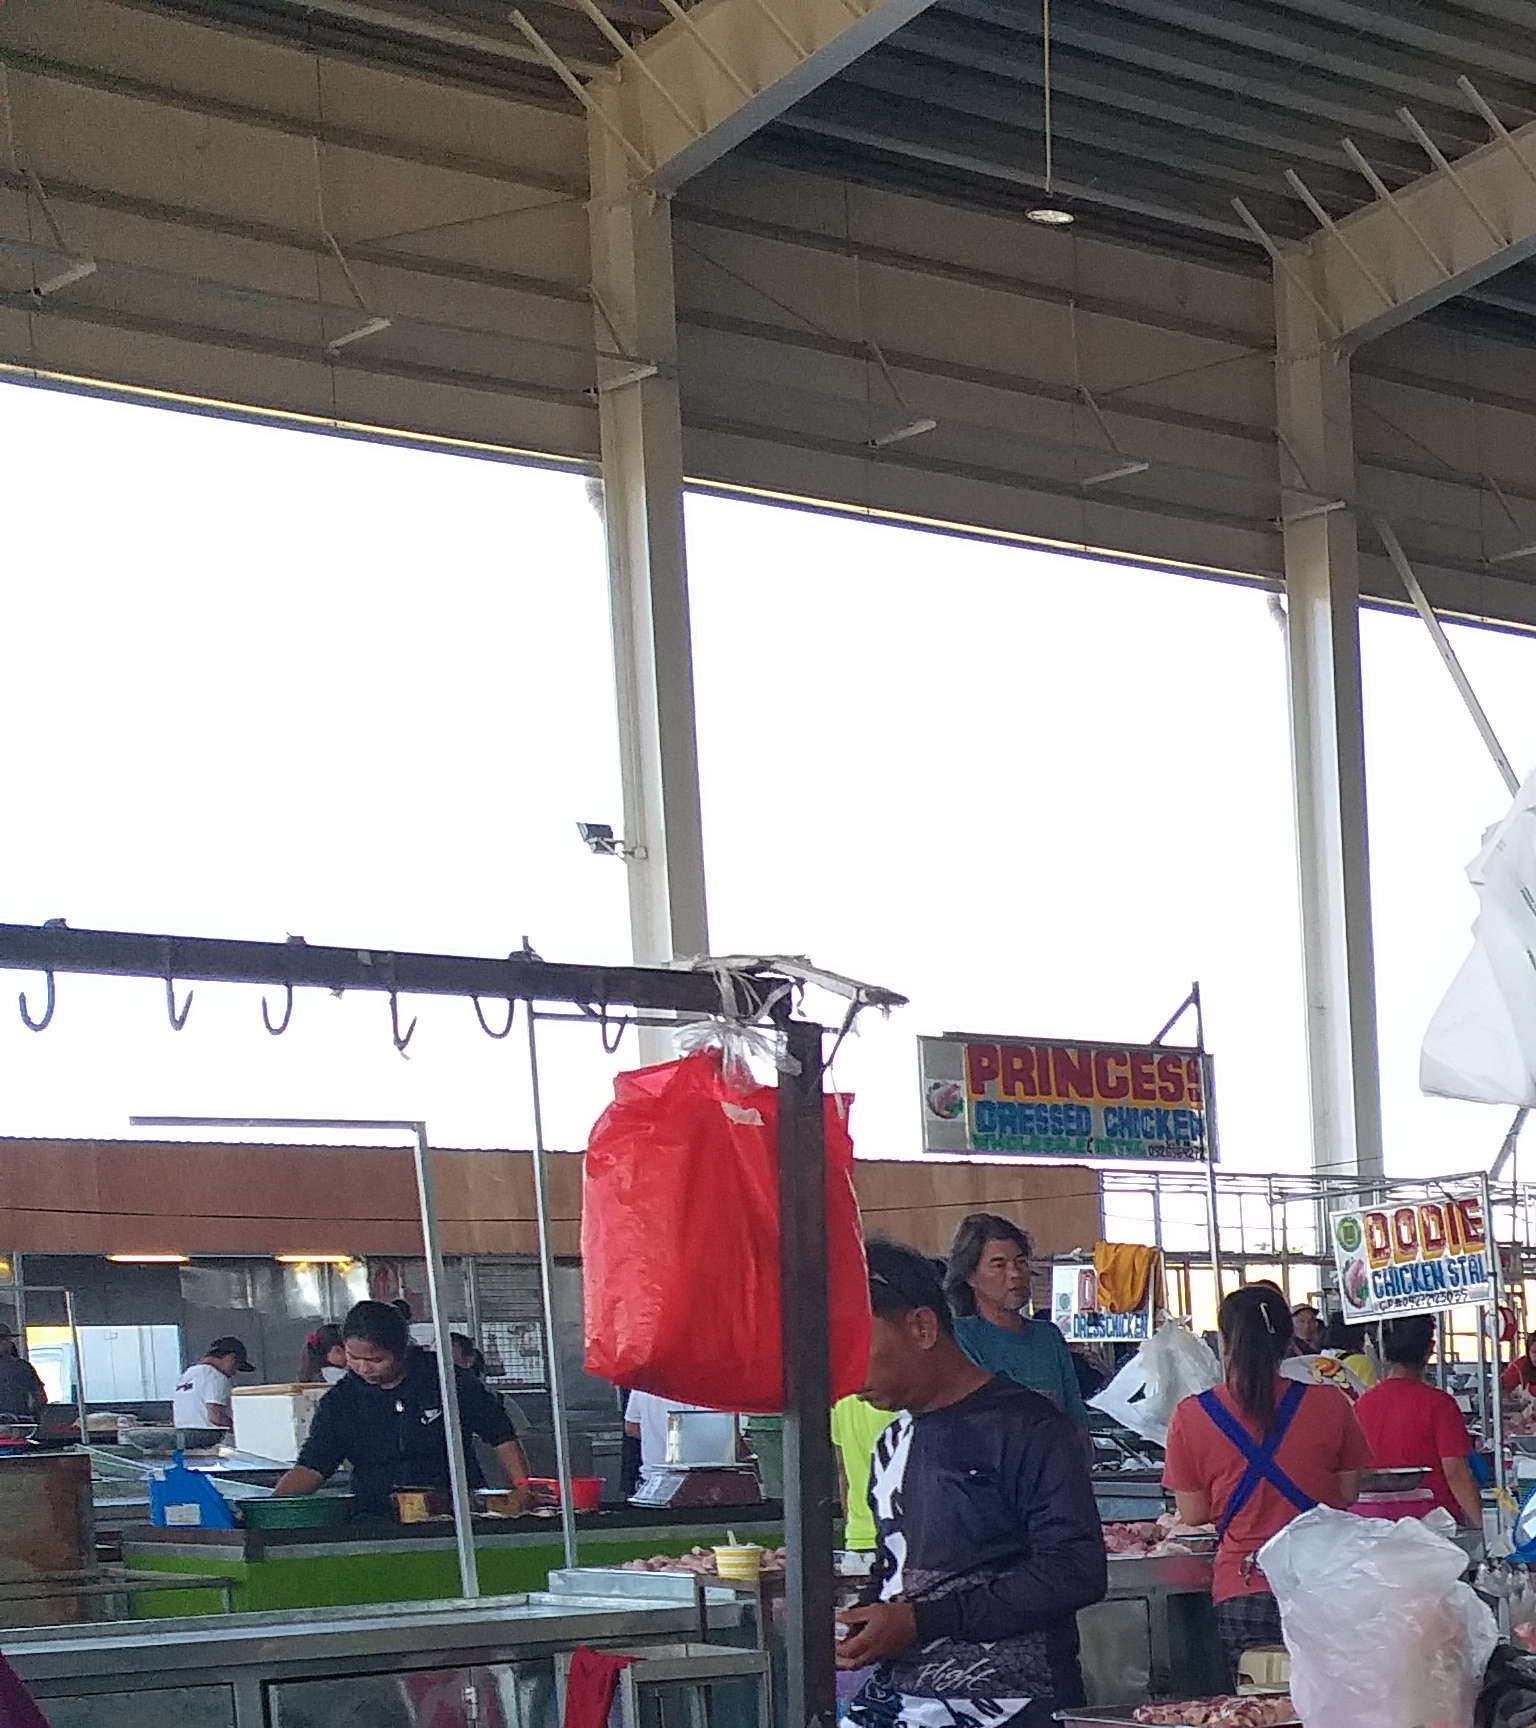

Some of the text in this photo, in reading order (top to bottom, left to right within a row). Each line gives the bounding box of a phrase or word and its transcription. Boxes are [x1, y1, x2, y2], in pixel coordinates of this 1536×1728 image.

[975, 1101, 1092, 1137] DRESSED
[1364, 1199, 1486, 1261] DODIE
[1371, 1260, 1446, 1299] CHICKEN
